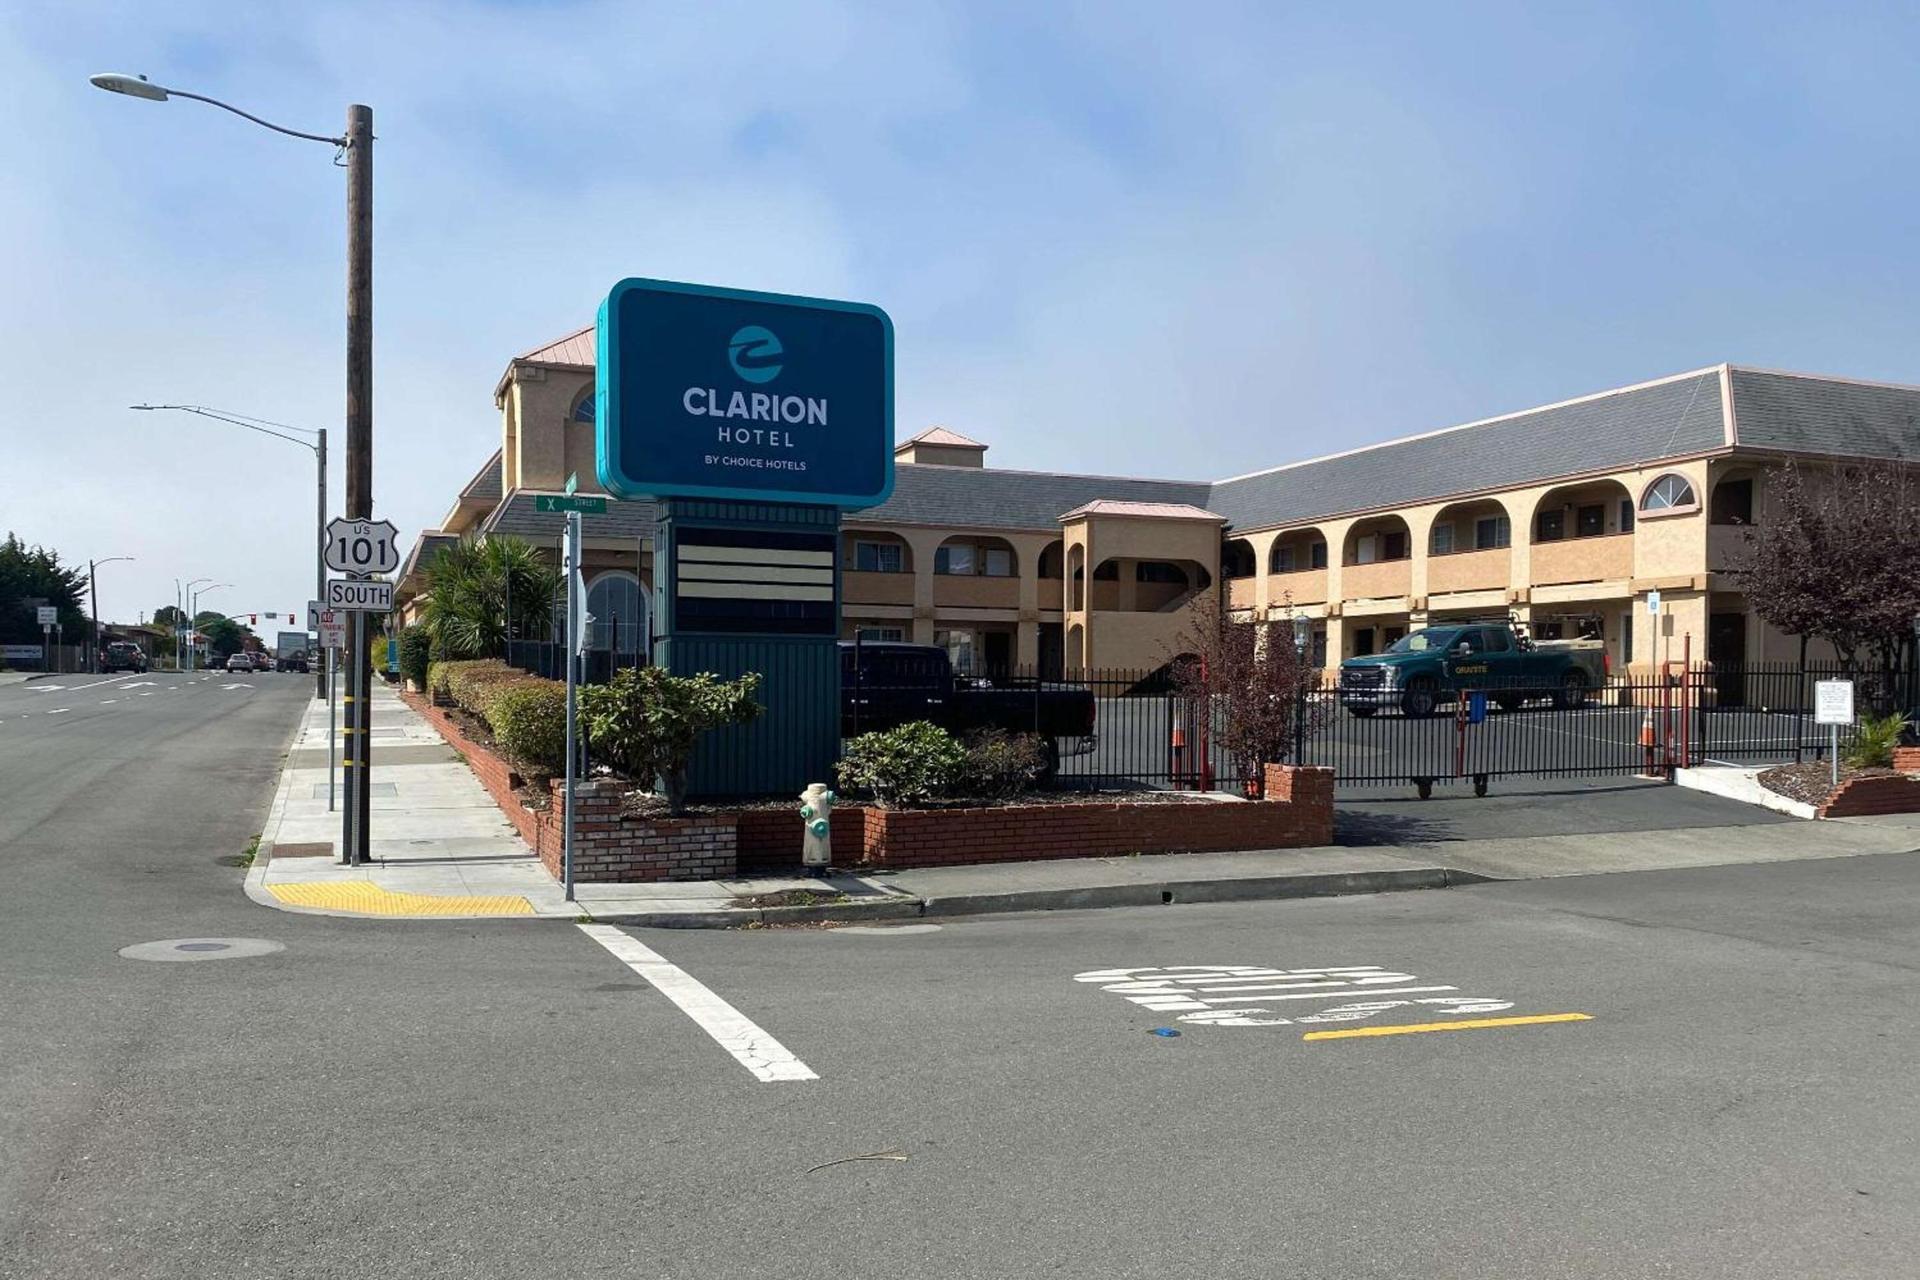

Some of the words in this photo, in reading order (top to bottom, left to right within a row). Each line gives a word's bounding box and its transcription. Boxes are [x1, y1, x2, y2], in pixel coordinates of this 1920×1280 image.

[683, 387, 828, 425] CLARION
[718, 426, 794, 447] HOTEL
[704, 455, 719, 464] BY
[722, 456, 763, 468] CHOICE
[766, 460, 807, 471] HOTELS
[547, 498, 555, 511] X
[574, 499, 596, 507] STREET
[354, 525, 370, 535] US
[338, 537, 386, 566] 101
[332, 584, 390, 604] SOUTH
